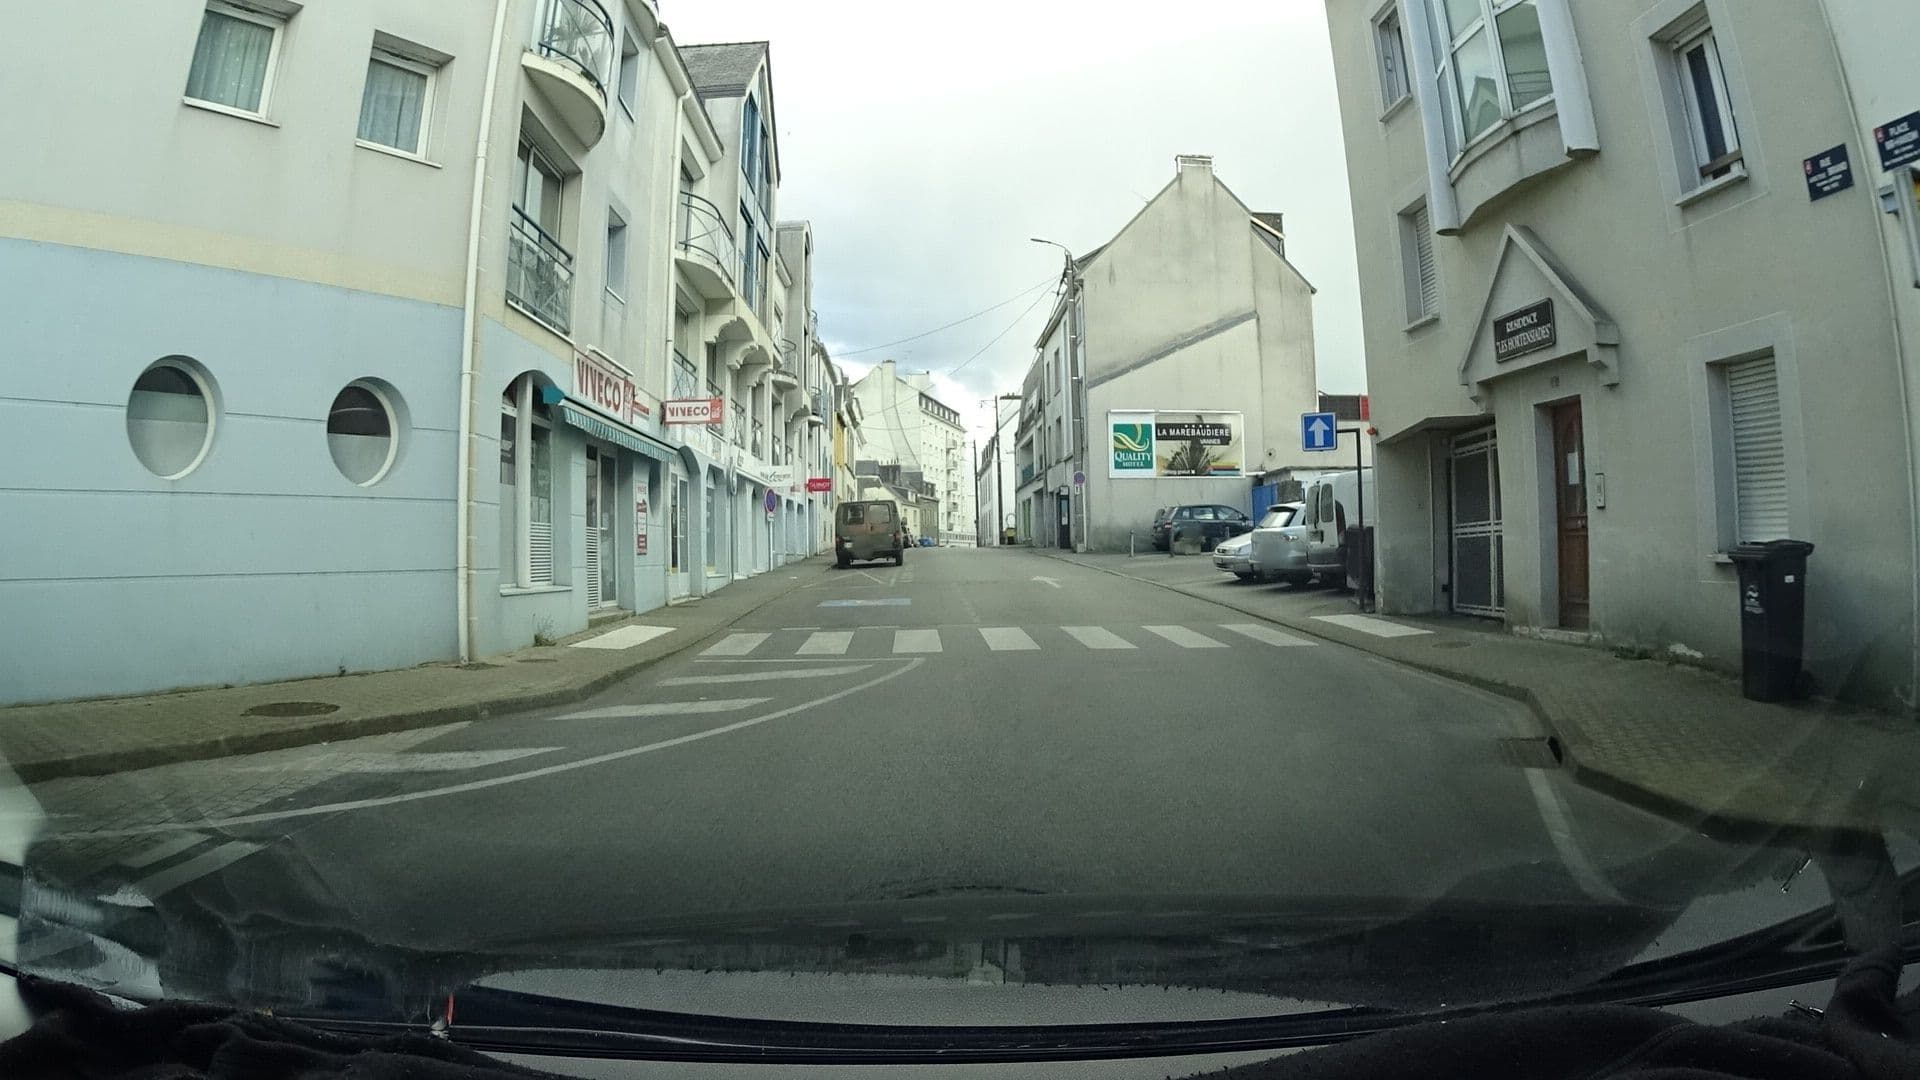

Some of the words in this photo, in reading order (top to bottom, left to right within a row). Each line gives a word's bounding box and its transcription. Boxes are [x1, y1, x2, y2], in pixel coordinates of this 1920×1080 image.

[577, 357, 621, 412] VIVECO
[668, 406, 709, 417] VIVECO
[1115, 452, 1152, 462] QUALITY
